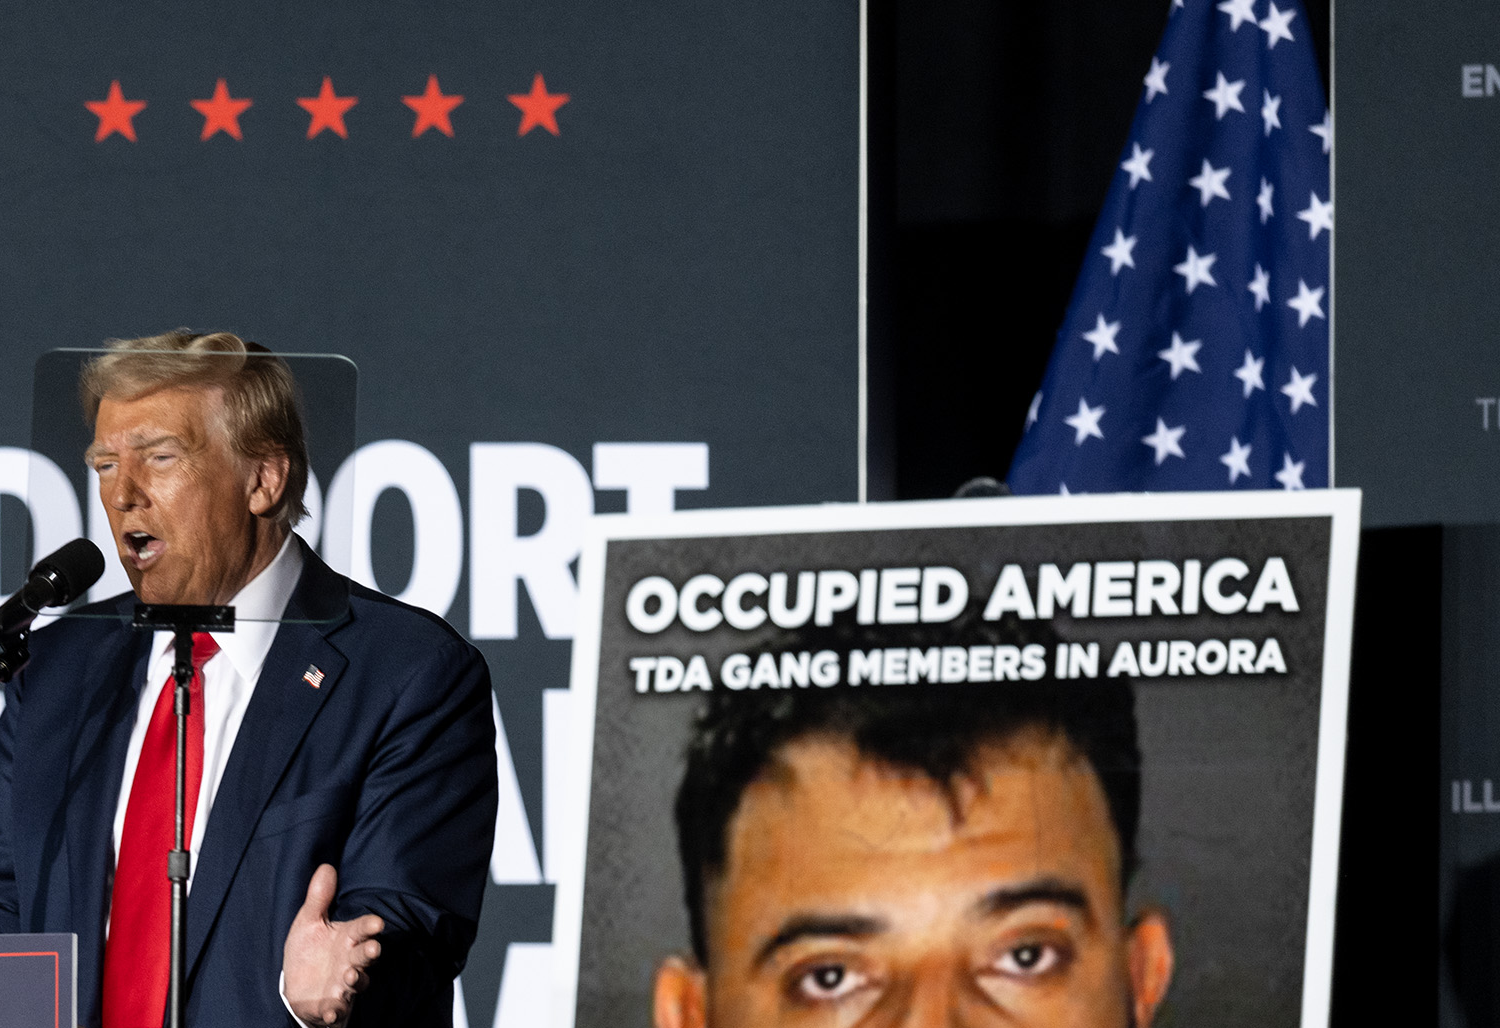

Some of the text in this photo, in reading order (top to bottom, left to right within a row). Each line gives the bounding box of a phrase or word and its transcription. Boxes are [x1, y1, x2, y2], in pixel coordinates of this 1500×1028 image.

[625, 556, 1300, 634] OCCUPIED AMERICA
[629, 637, 1288, 693] TDA GANG MEMBERS IN AURORA
